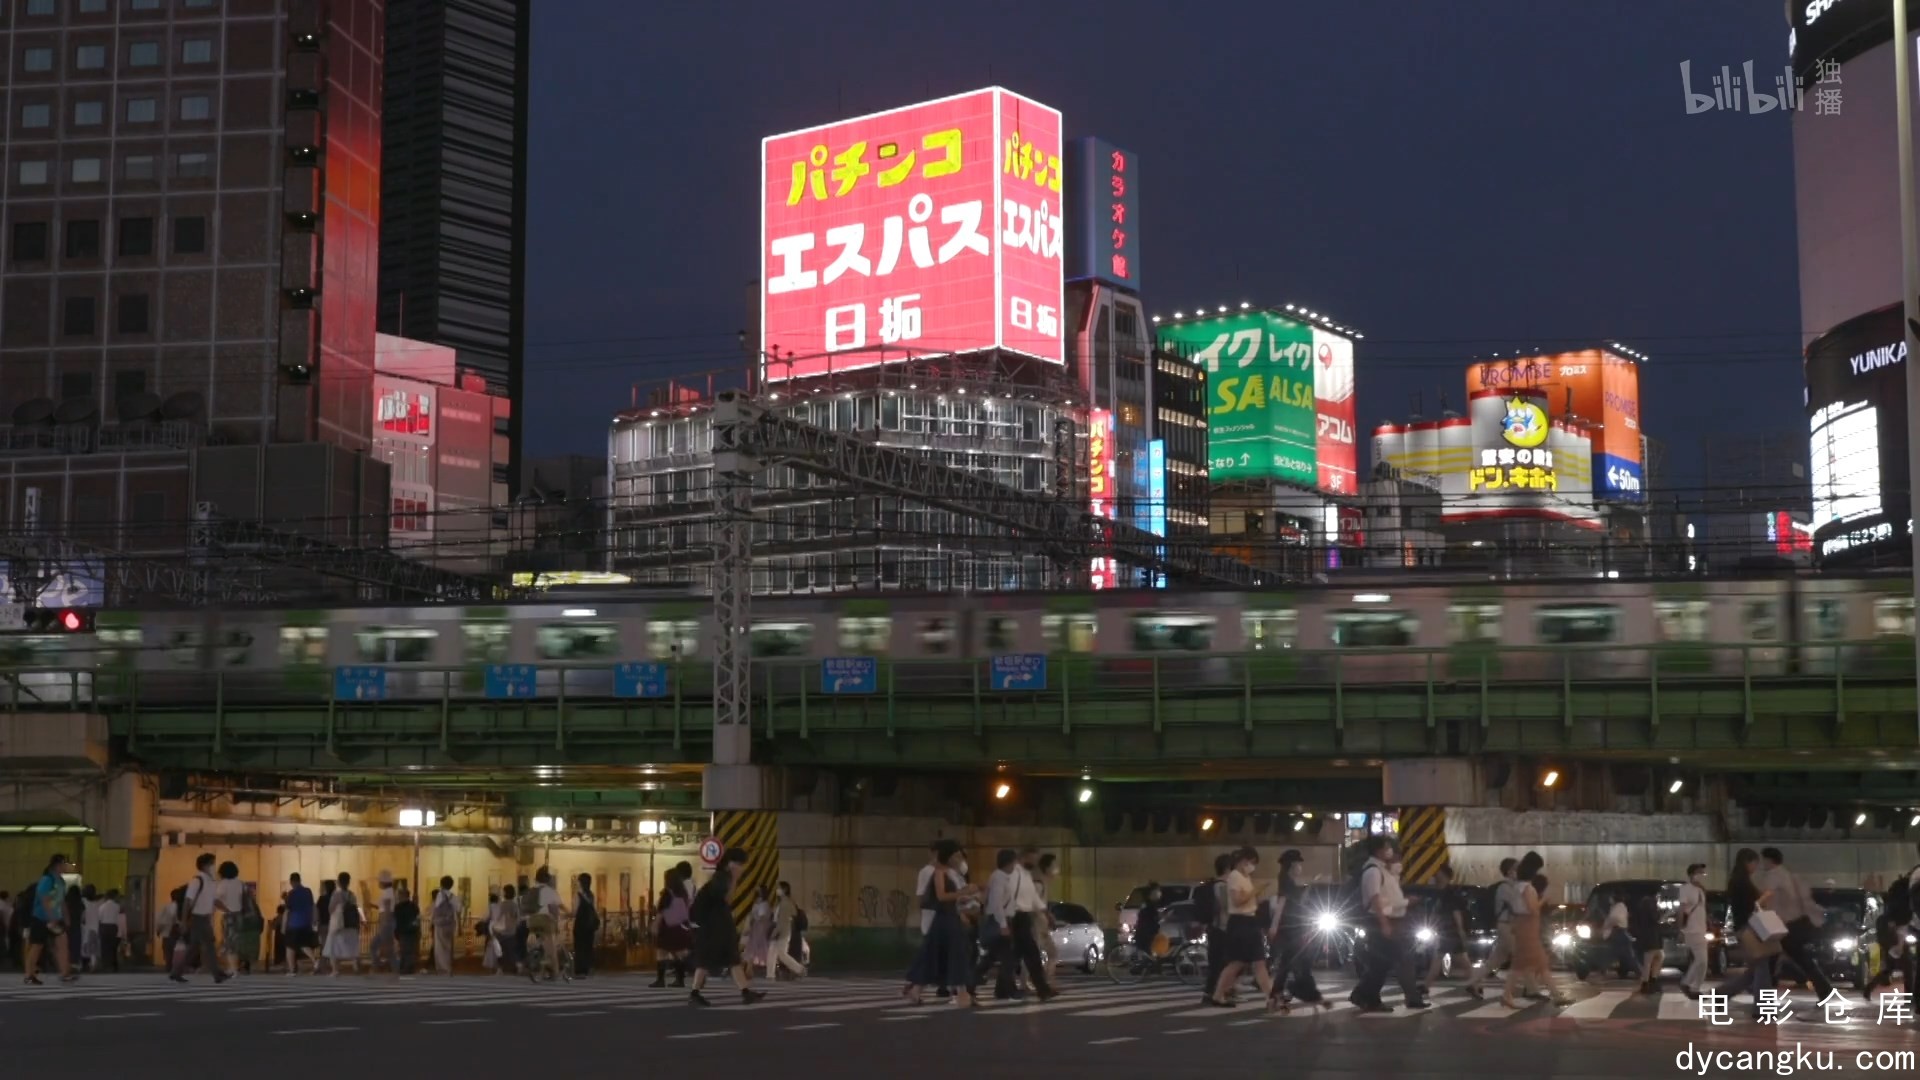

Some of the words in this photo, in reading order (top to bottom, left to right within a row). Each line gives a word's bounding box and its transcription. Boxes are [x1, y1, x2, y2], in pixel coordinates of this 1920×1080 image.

[786, 128, 962, 206] パチンコ
[1004, 131, 1061, 193] パチンコ
[768, 193, 989, 294] エスパス
[1003, 199, 1063, 260] エスパス
[1269, 333, 1311, 371] レイク
[1851, 341, 1907, 375] YUNIKA
[1480, 363, 1551, 386] PROMISE
[1269, 376, 1313, 410] ALSA
[1317, 413, 1353, 444] アコム
[1091, 421, 1104, 492] パチンコ
[1330, 474, 1343, 488] 3F
[1620, 468, 1640, 490] 50m
